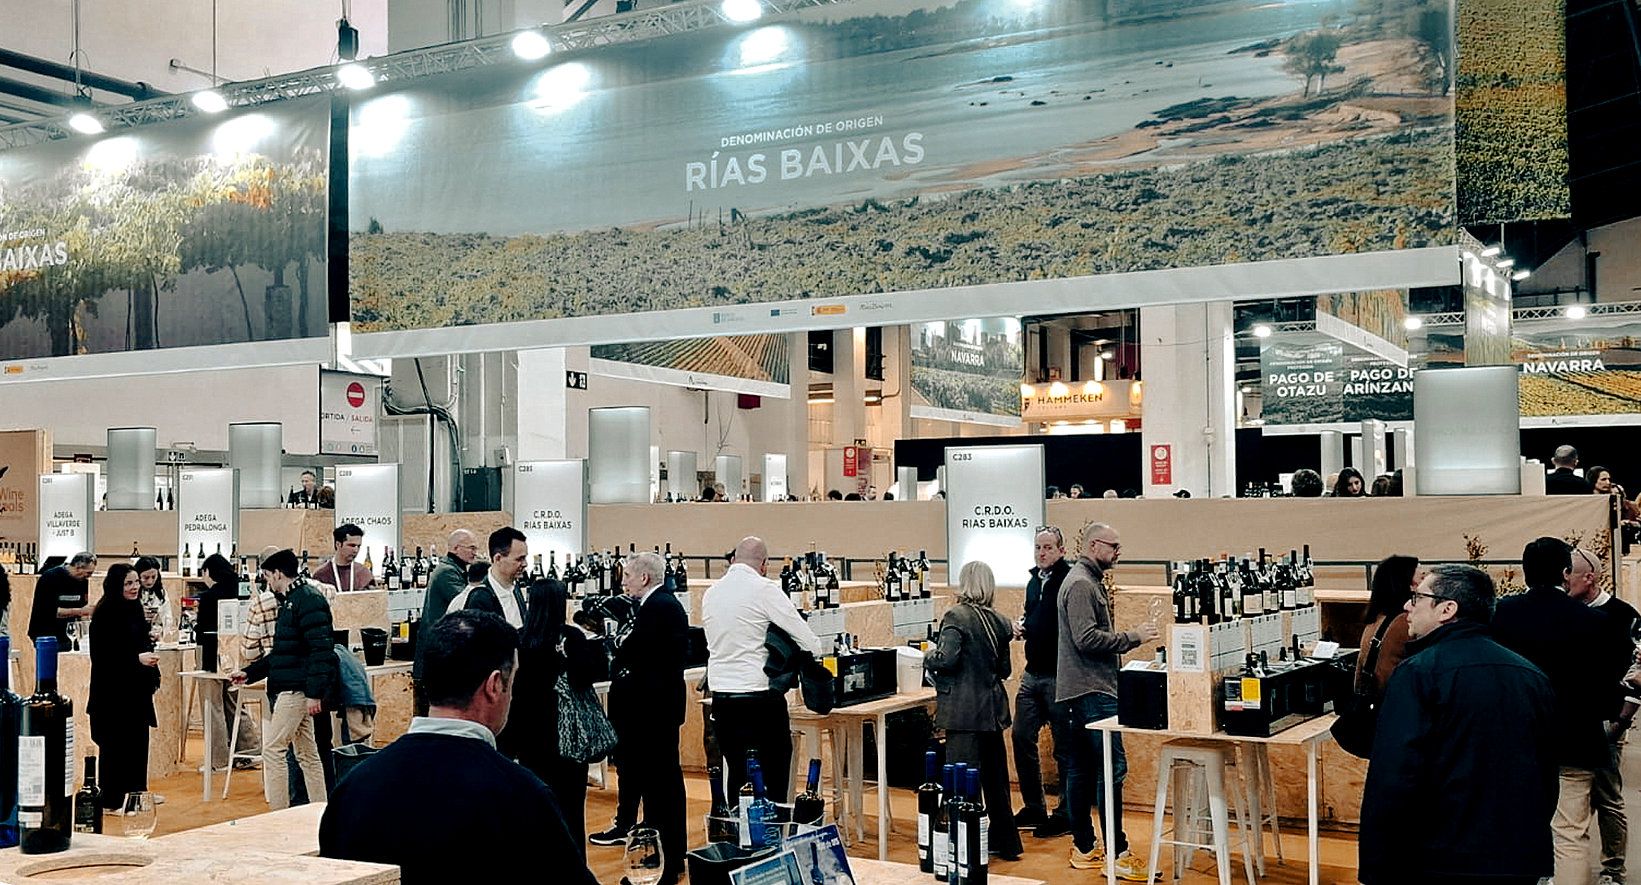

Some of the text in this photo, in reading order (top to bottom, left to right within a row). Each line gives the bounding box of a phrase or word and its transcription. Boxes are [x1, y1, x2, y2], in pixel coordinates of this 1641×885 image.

[721, 116, 883, 148] DENOMINACIÓN DE ORIGEN
[686, 132, 925, 191] RÍAS BAIXAS
[0, 242, 68, 270] AIXAS
[951, 350, 985, 367] NAVARRA
[1523, 359, 1605, 373] NAVARRA
[1269, 371, 1334, 385] PAGO DE
[1350, 368, 1393, 381] PAGO
[1276, 385, 1327, 397] OTAZU
[1037, 393, 1103, 404] HAMMEKEN
[952, 453, 972, 461] C283
[974, 505, 1015, 516] C.R.D.O.
[46, 520, 81, 528] VILLAVERDE
[366, 516, 392, 525] CHAOS
[523, 520, 572, 530] RIAS BAIXAS
[962, 518, 1029, 529] RIAS BAIXAS
[184, 523, 227, 532] PEDRALONGA
